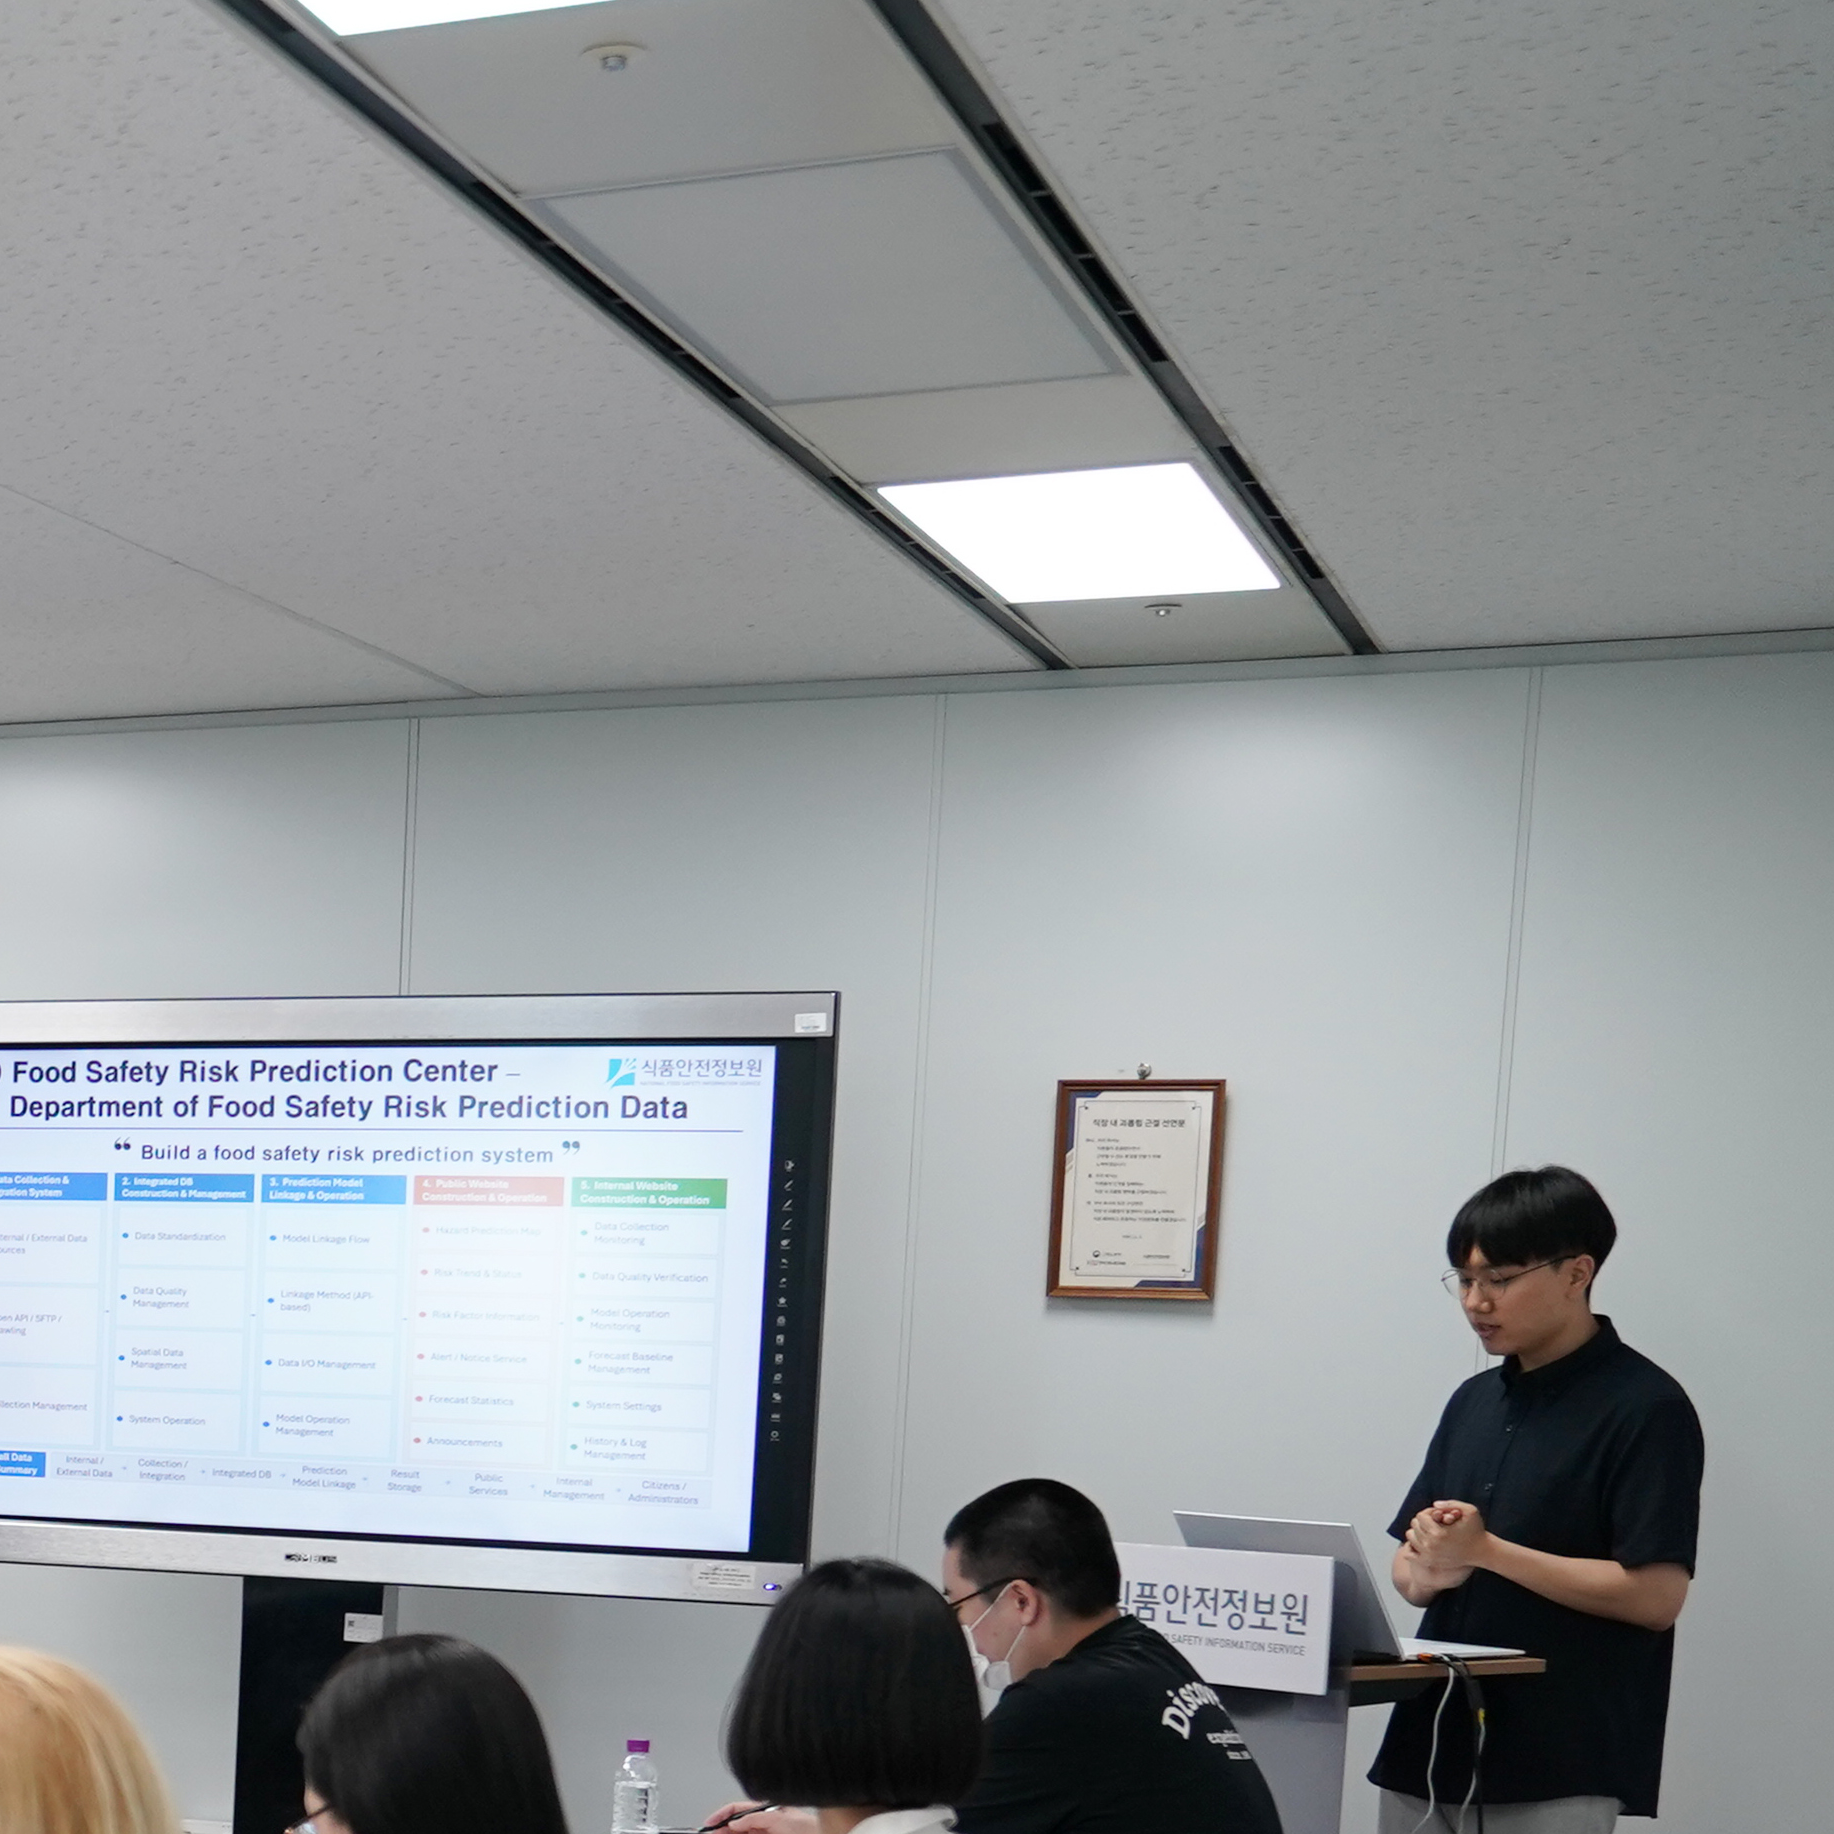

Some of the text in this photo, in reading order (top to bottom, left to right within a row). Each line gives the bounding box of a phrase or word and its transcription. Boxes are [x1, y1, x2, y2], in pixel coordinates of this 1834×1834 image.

[13, 1061, 76, 1083] Food
[86, 1060, 169, 1086] Safety
[180, 1060, 239, 1083] Risk
[250, 1059, 393, 1083] Prediction
[403, 1059, 498, 1082] Center
[641, 1059, 763, 1078] 식품안전정보원
[10, 1094, 688, 1121] Department of Food Safety Risk Prediction Data
[141, 1145, 553, 1164] Build a food safety risk prediction system
[1172, 1634, 1203, 1647] SAFETY
[1205, 1638, 1266, 1652] INFORMATION
[1267, 1643, 1305, 1656] SERVICE
